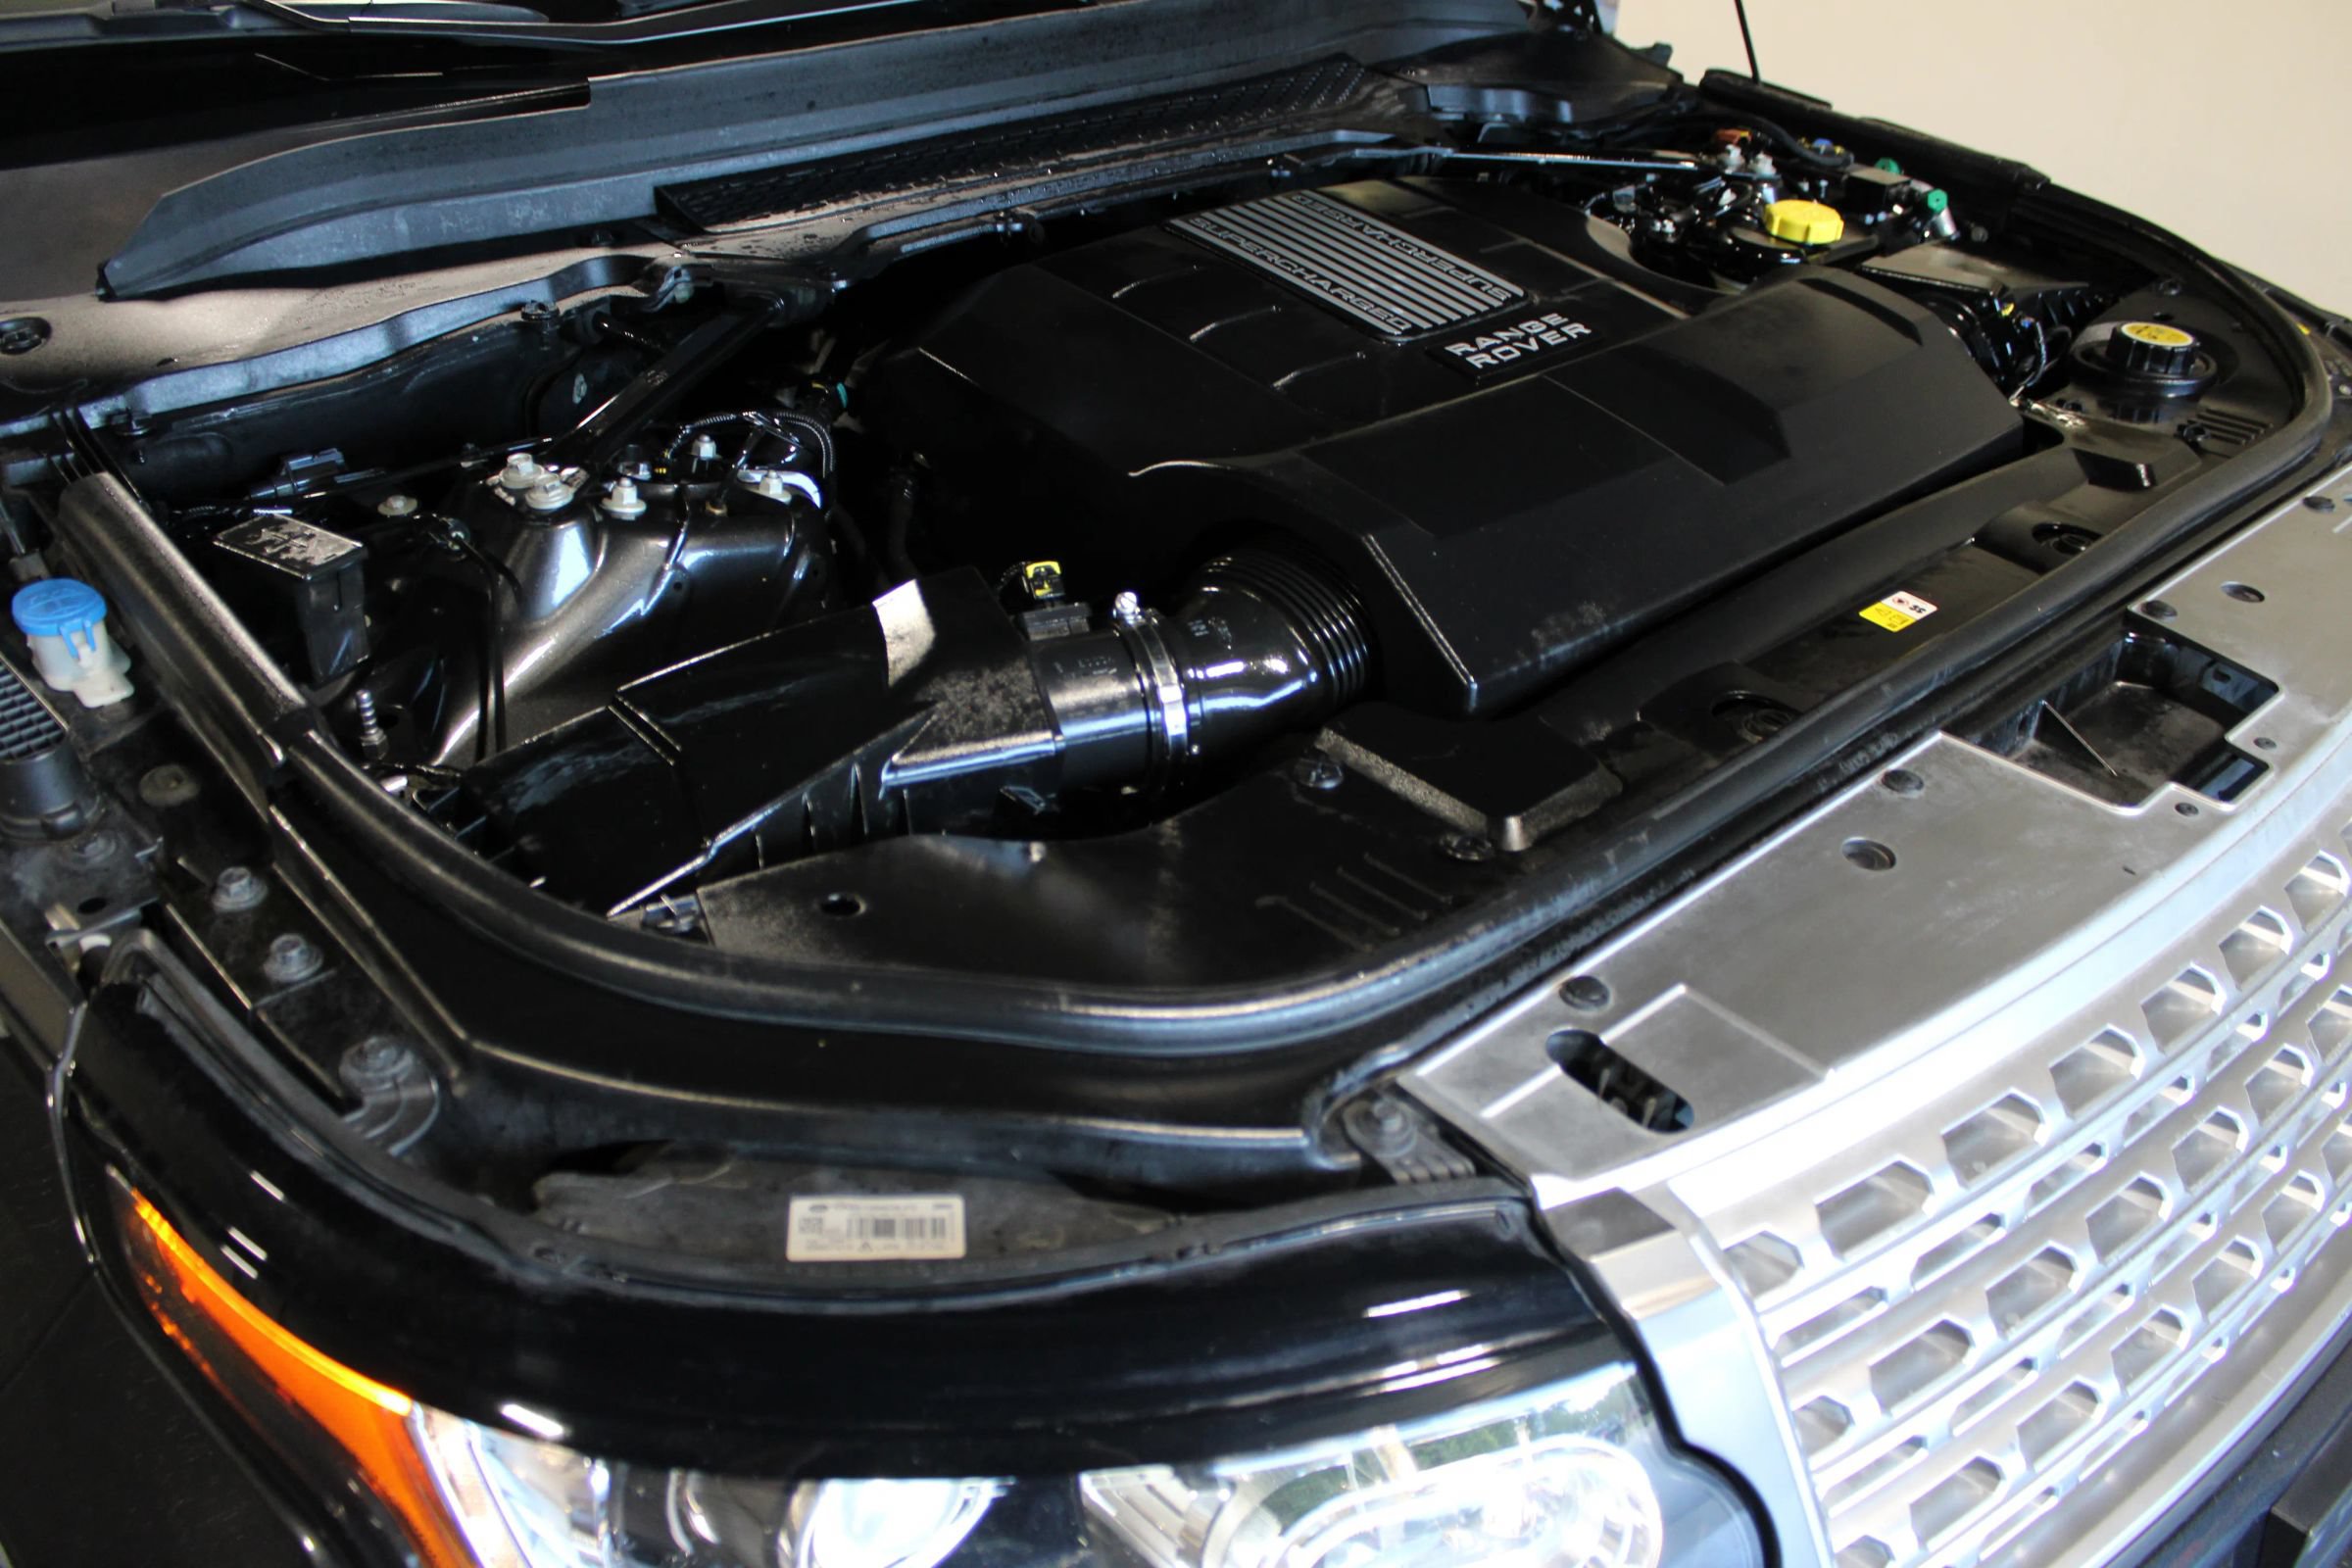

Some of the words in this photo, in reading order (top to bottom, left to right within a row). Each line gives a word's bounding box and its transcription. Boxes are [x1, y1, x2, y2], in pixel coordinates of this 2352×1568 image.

[1188, 217, 1412, 330] SUPERCHARGED
[1291, 196, 1512, 300] SUPERCHARGED
[1445, 313, 1569, 357] RANGE
[1466, 322, 1592, 369] ROVER
